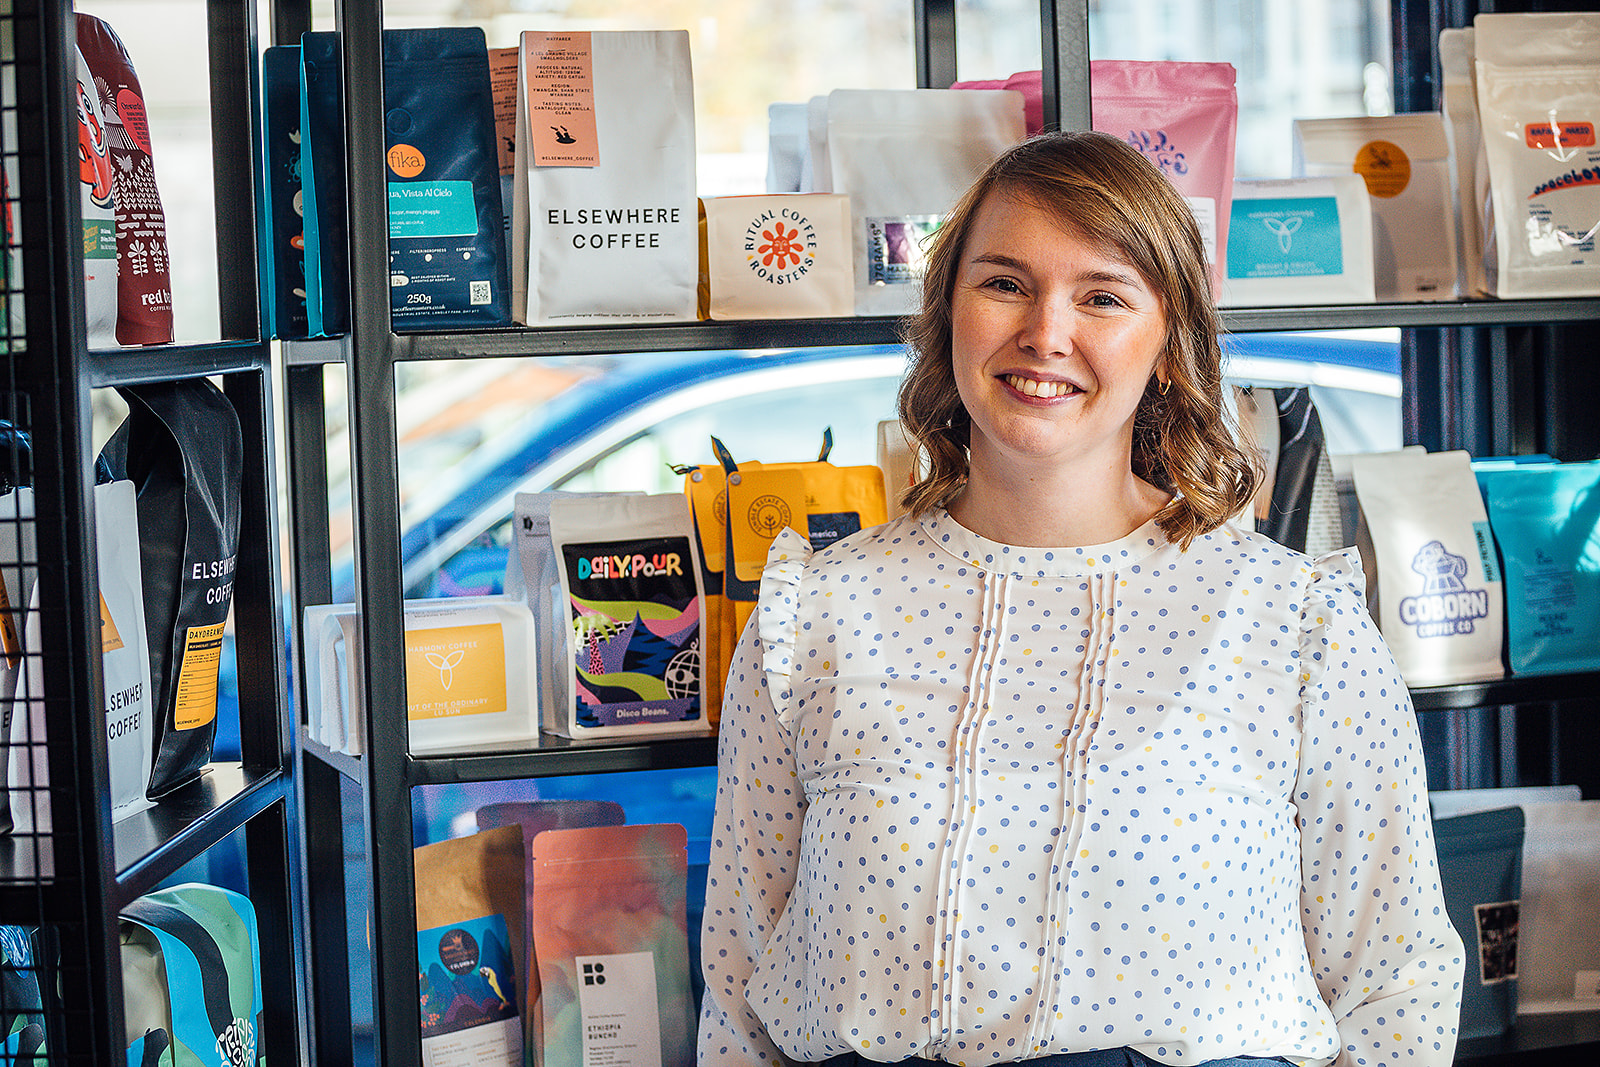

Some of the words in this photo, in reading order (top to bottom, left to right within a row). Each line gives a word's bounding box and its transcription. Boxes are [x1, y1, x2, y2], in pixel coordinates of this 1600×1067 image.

[401, 189, 424, 198] Vista
[424, 188, 433, 197] Al
[433, 188, 453, 197] Cielo
[548, 208, 680, 224] ELSEWHERE
[745, 209, 776, 250] RITUAL
[781, 208, 817, 248] COFFEE
[572, 233, 659, 249] COFFEE
[750, 257, 813, 285] ROASTERS
[141, 289, 163, 306] red
[407, 293, 432, 305] 250g
[1400, 590, 1487, 625] COBORN
[1418, 621, 1455, 637] COFFEE
[1456, 619, 1474, 634] CO
[408, 644, 446, 653] HARMONY
[448, 641, 478, 649] COFFEE
[434, 701, 448, 709] THE
[450, 697, 488, 706] ORDINARY
[616, 709, 640, 718] Disco
[641, 707, 669, 716] Beans.
[588, 1023, 621, 1032] ETHIOPIA
